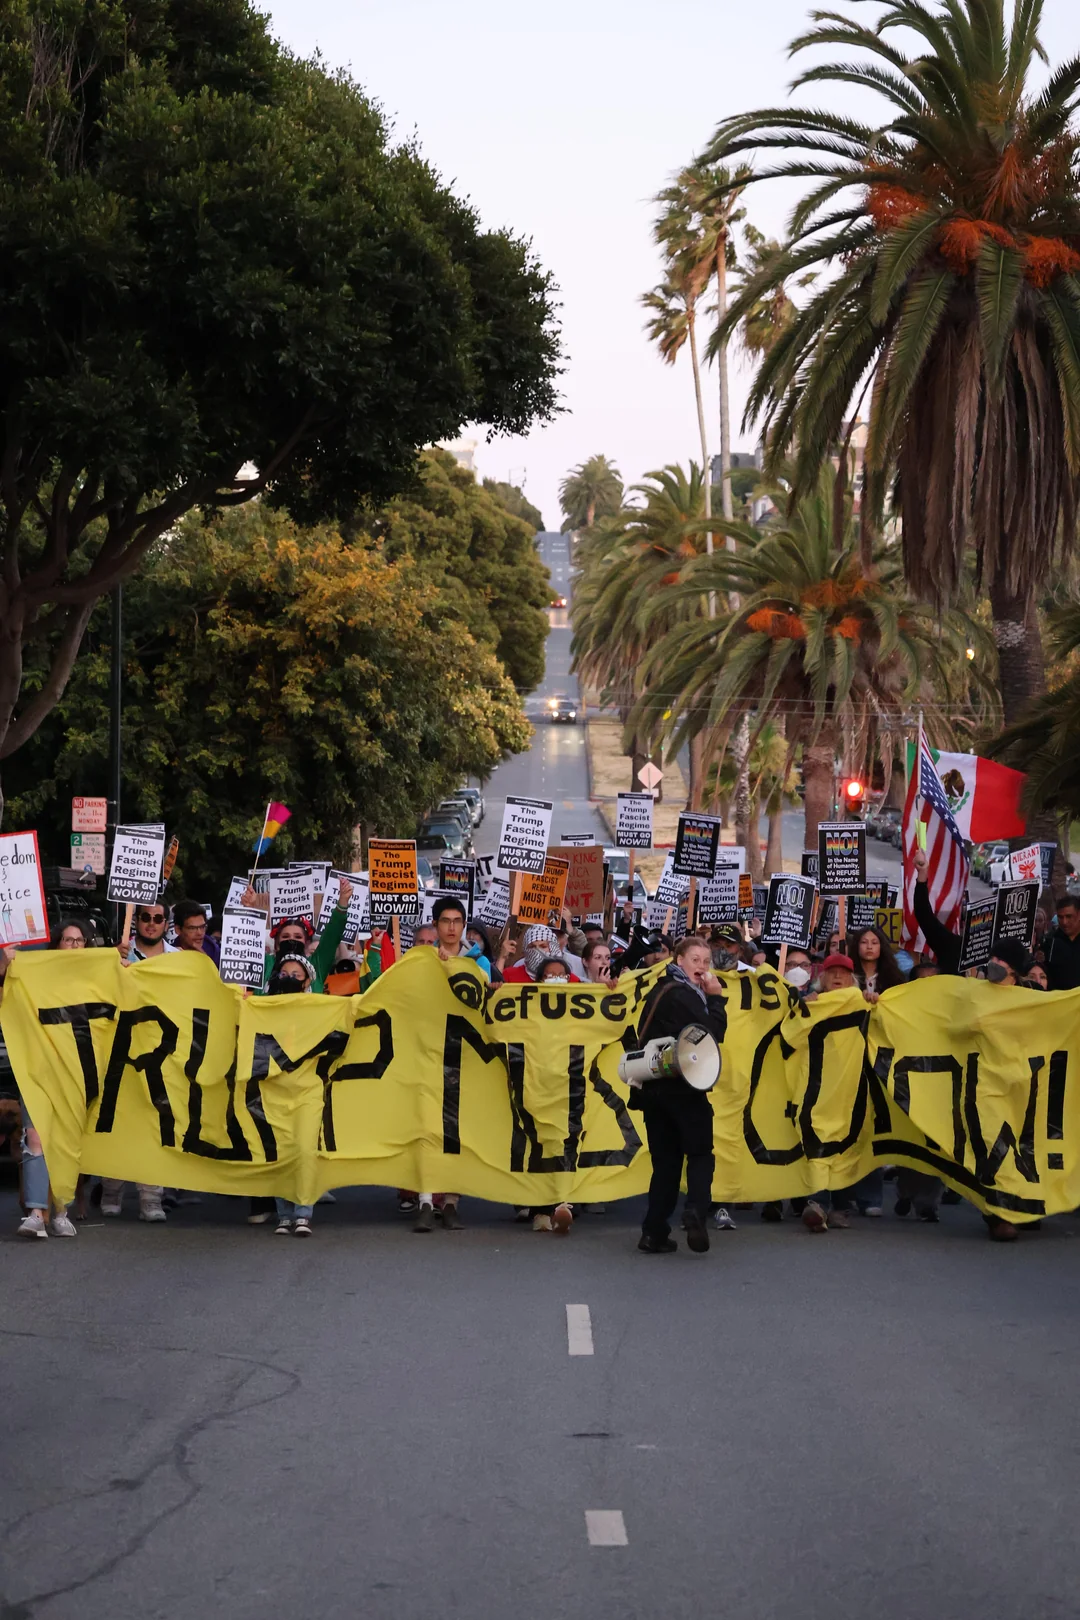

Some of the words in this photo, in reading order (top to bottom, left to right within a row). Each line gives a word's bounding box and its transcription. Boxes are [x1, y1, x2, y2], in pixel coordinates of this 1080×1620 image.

[74, 798, 82, 807] NO
[511, 815, 543, 827] Trump
[506, 824, 545, 837] Fascist
[683, 820, 714, 844] NO!
[74, 836, 80, 844] 2
[504, 835, 544, 847] Regime
[826, 832, 858, 855] NO!
[0, 844, 36, 868] edom
[122, 846, 154, 858] Trump
[501, 848, 527, 857] MUST
[573, 852, 597, 864] KING
[1012, 846, 1040, 864] MIGRANT
[117, 855, 157, 867] Fascist
[374, 859, 411, 870] Trump
[502, 856, 540, 869] NOW!!!
[115, 866, 156, 878] Regime
[372, 870, 414, 878] Fascist
[445, 866, 469, 888] NO!
[112, 878, 139, 888] MUST
[372, 880, 415, 891] Regime
[532, 875, 558, 885] FASCIST
[113, 888, 152, 900] NOW!!!
[277, 886, 307, 894] Trump
[532, 883, 555, 894] REGIME
[658, 887, 679, 896] MUST
[0, 889, 31, 902] tice
[274, 893, 310, 904] Fascist
[523, 892, 547, 904] MUST
[550, 897, 560, 907] GO
[658, 895, 679, 904] NOW
[776, 884, 805, 908] NO!
[374, 903, 416, 913] NOW!!!
[1005, 890, 1030, 915] NO!
[274, 904, 310, 915] Regime
[484, 906, 507, 917] Regime
[519, 906, 546, 920] NOW!
[481, 914, 496, 924] MUST
[231, 926, 260, 938] Trump
[777, 929, 796, 938] Accept
[780, 923, 802, 932] REFUSE
[876, 912, 899, 943] RE
[226, 936, 262, 948] Fascist
[225, 948, 262, 959] Regime
[222, 961, 250, 970] MUST
[225, 970, 260, 982] NOW!!!
[38, 1002, 394, 1162] TRUMP
[443, 1013, 643, 1173] MUS
[743, 1010, 871, 1165] GO
[863, 1046, 1068, 1187] NOW!
